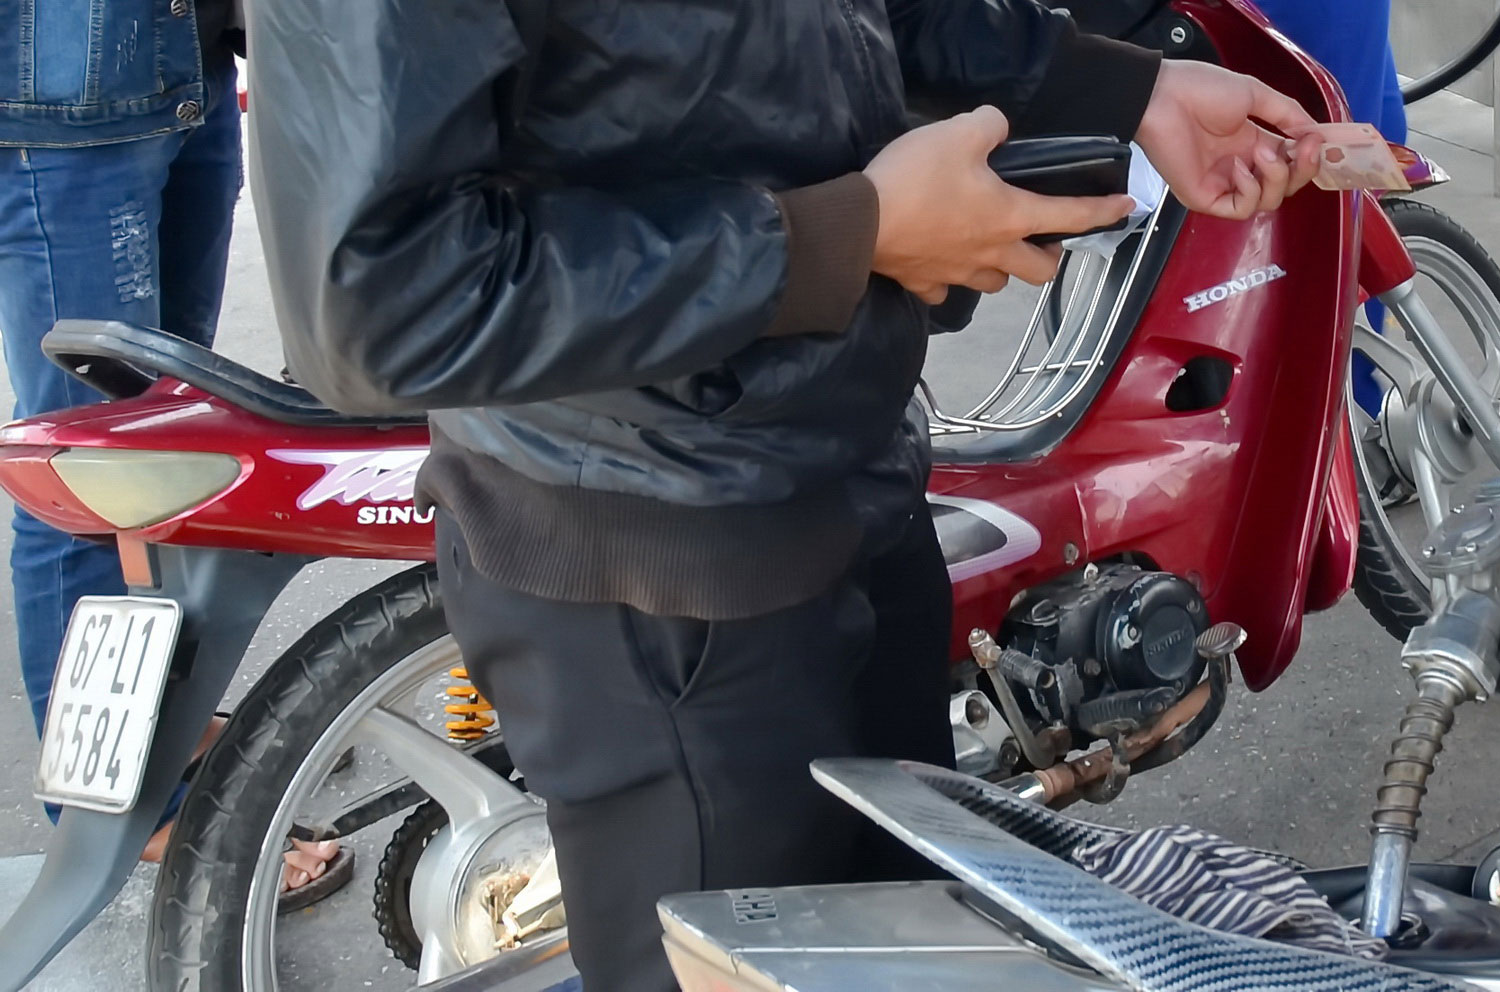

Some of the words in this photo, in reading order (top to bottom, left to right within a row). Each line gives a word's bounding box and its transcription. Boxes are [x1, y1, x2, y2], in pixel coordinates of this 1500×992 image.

[1183, 263, 1287, 314] HONDA
[357, 506, 436, 525] SINU
[70, 613, 156, 696] 67-L1
[47, 702, 130, 791] 5584
